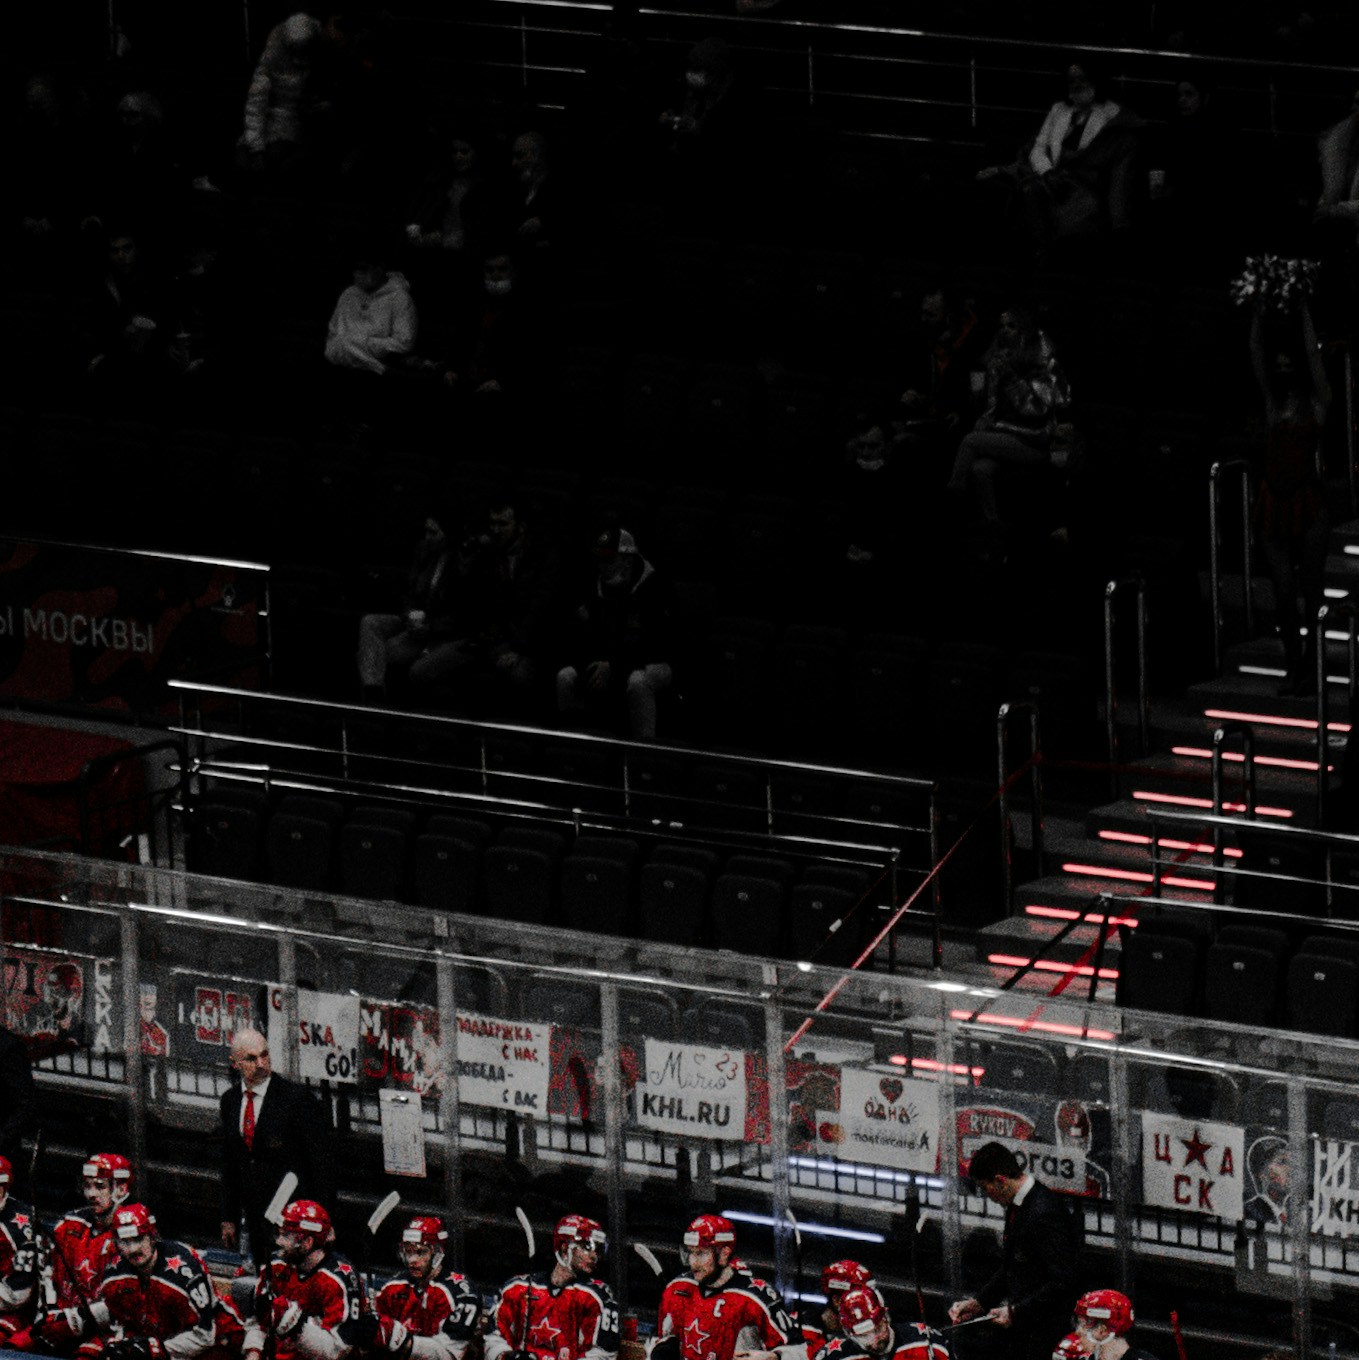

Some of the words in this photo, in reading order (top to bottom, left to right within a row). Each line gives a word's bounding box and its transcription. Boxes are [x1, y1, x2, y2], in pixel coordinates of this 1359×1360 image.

[22, 606, 155, 654] МОСКВЫ
[325, 1048, 357, 1077] GO!
[642, 1091, 731, 1128] KHL.RU
[1016, 1150, 1075, 1179] огаз
